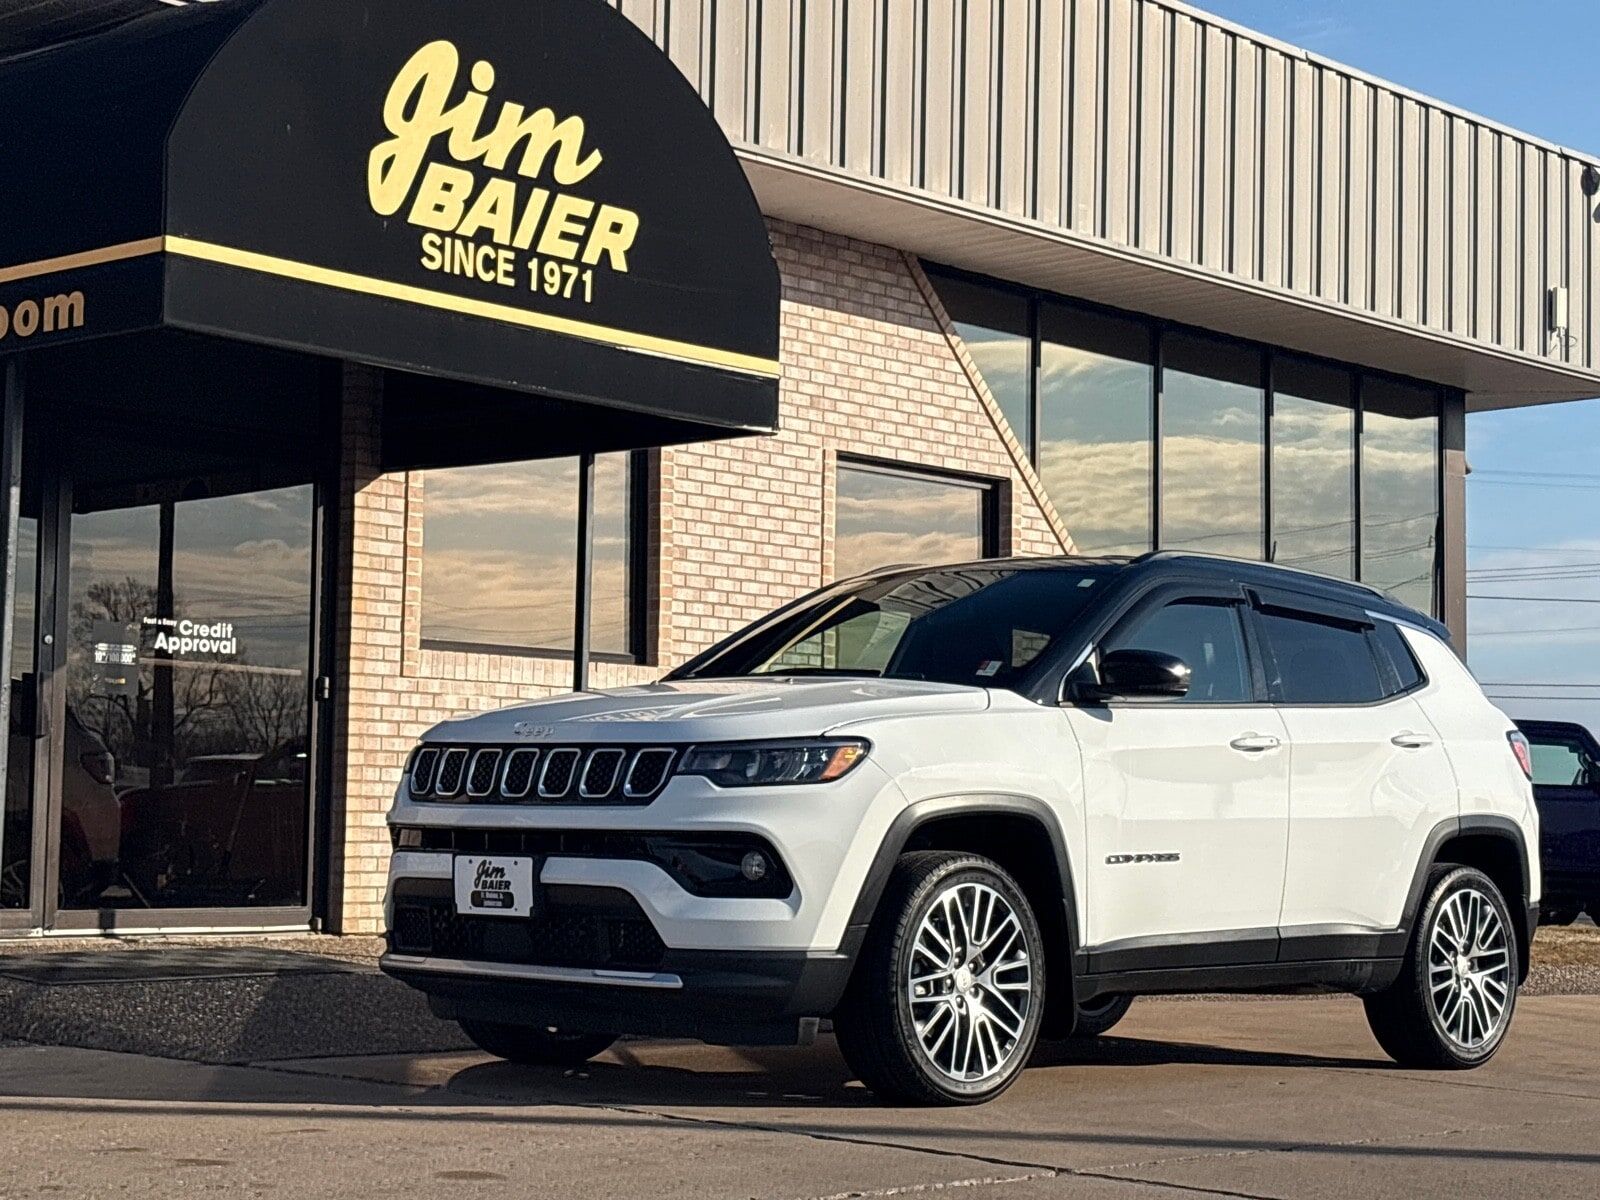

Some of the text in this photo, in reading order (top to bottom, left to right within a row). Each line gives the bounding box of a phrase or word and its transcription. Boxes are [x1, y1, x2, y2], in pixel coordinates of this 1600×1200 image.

[368, 40, 603, 216] Jim
[407, 162, 639, 273] BAIER
[421, 232, 593, 303] SINCE 1971
[154, 632, 237, 655] Approval
[179, 619, 234, 639] Credit
[474, 859, 506, 889] Jim
[481, 880, 512, 891] BAIER
